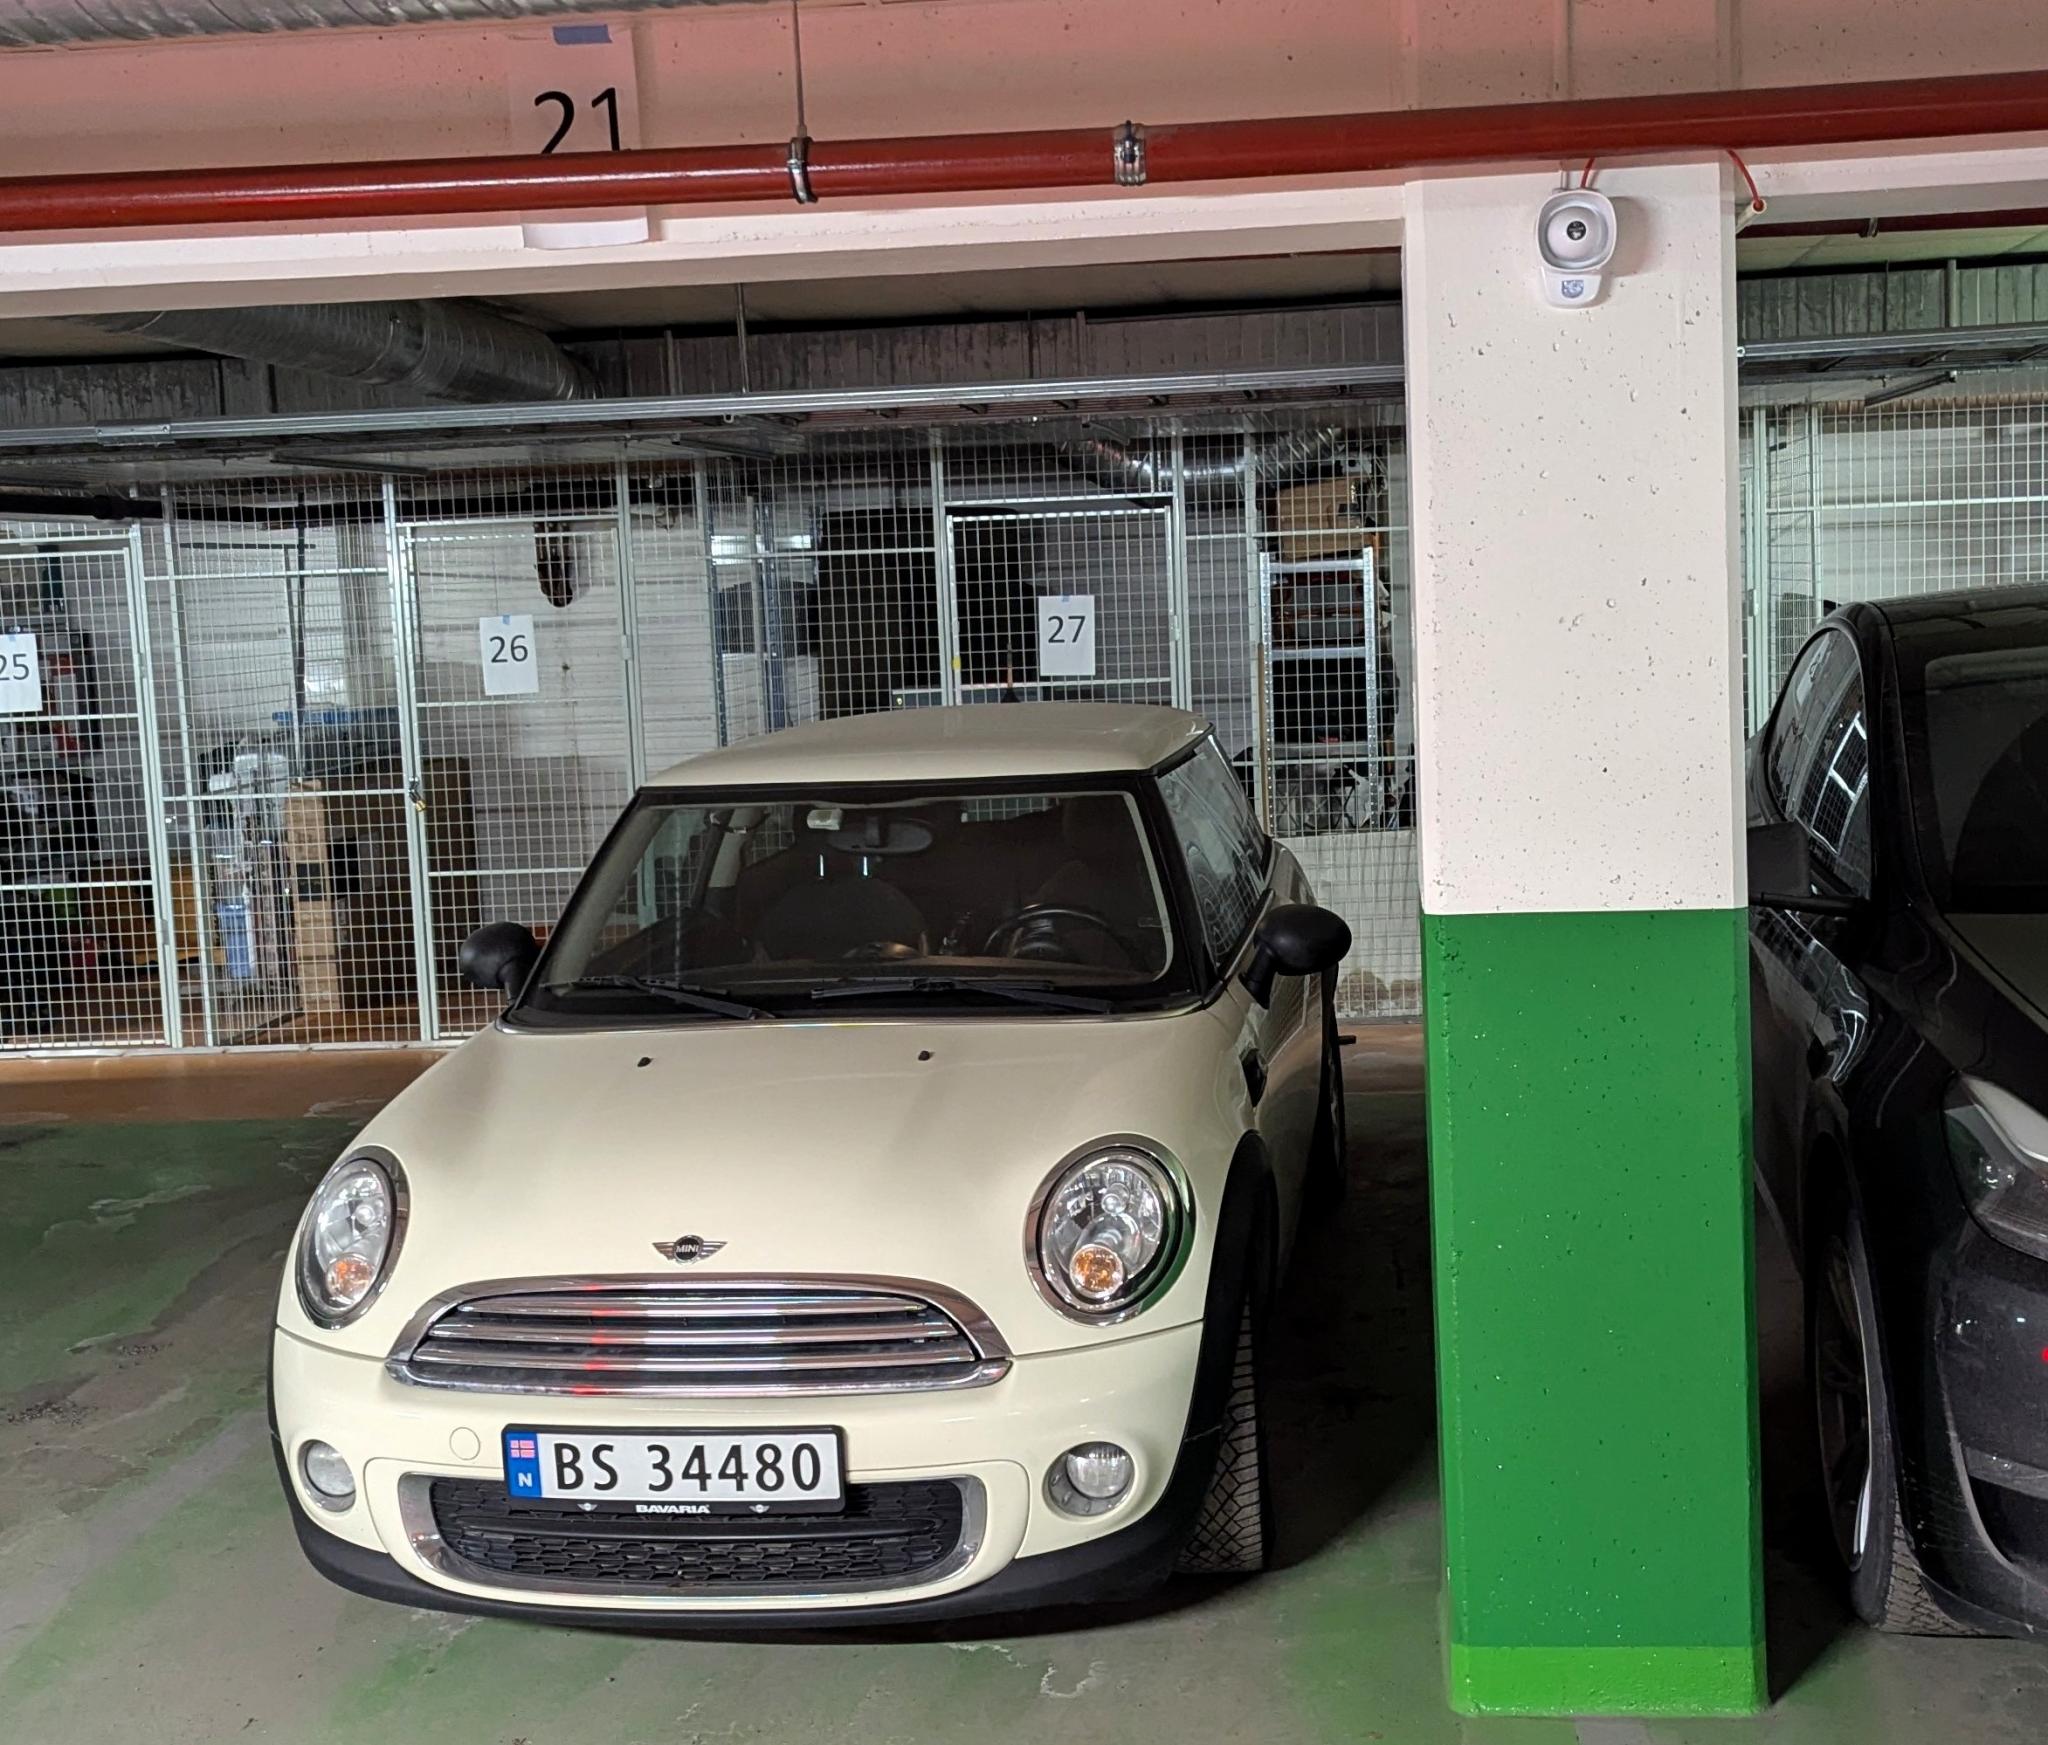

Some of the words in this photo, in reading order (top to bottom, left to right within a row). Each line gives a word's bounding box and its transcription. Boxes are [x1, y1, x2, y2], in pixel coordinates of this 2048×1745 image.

[534, 87, 620, 154] 21
[1047, 615, 1086, 644] 27
[489, 634, 529, 664] 26
[675, 1244, 700, 1253] MINI
[517, 1472, 533, 1488] N
[554, 1442, 618, 1491] BS
[646, 1442, 821, 1492] 34480
[635, 1503, 711, 1514] BAVARIA
